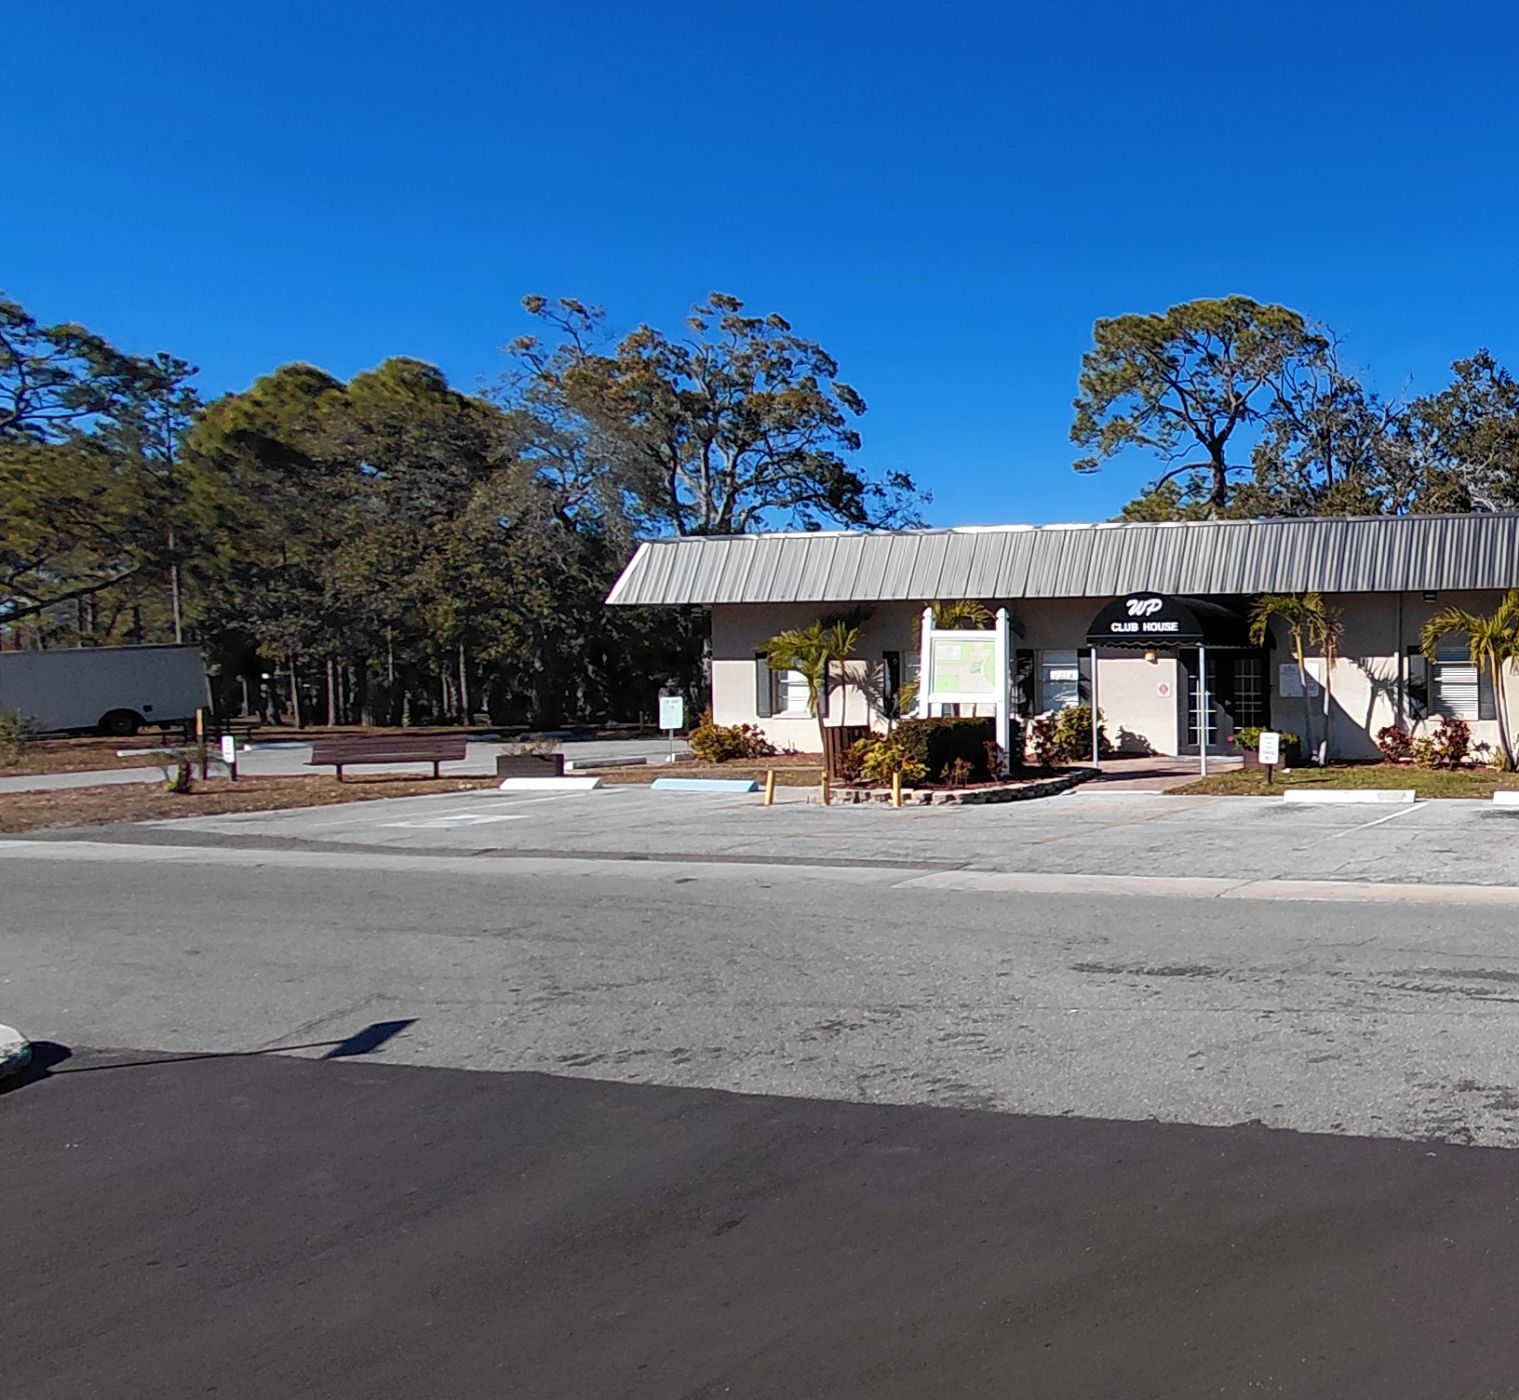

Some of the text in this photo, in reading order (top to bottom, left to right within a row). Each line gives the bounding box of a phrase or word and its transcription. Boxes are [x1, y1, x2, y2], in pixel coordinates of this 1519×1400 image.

[1126, 598, 1163, 616] WP
[1110, 622, 1179, 632] CLUB HOUSE
